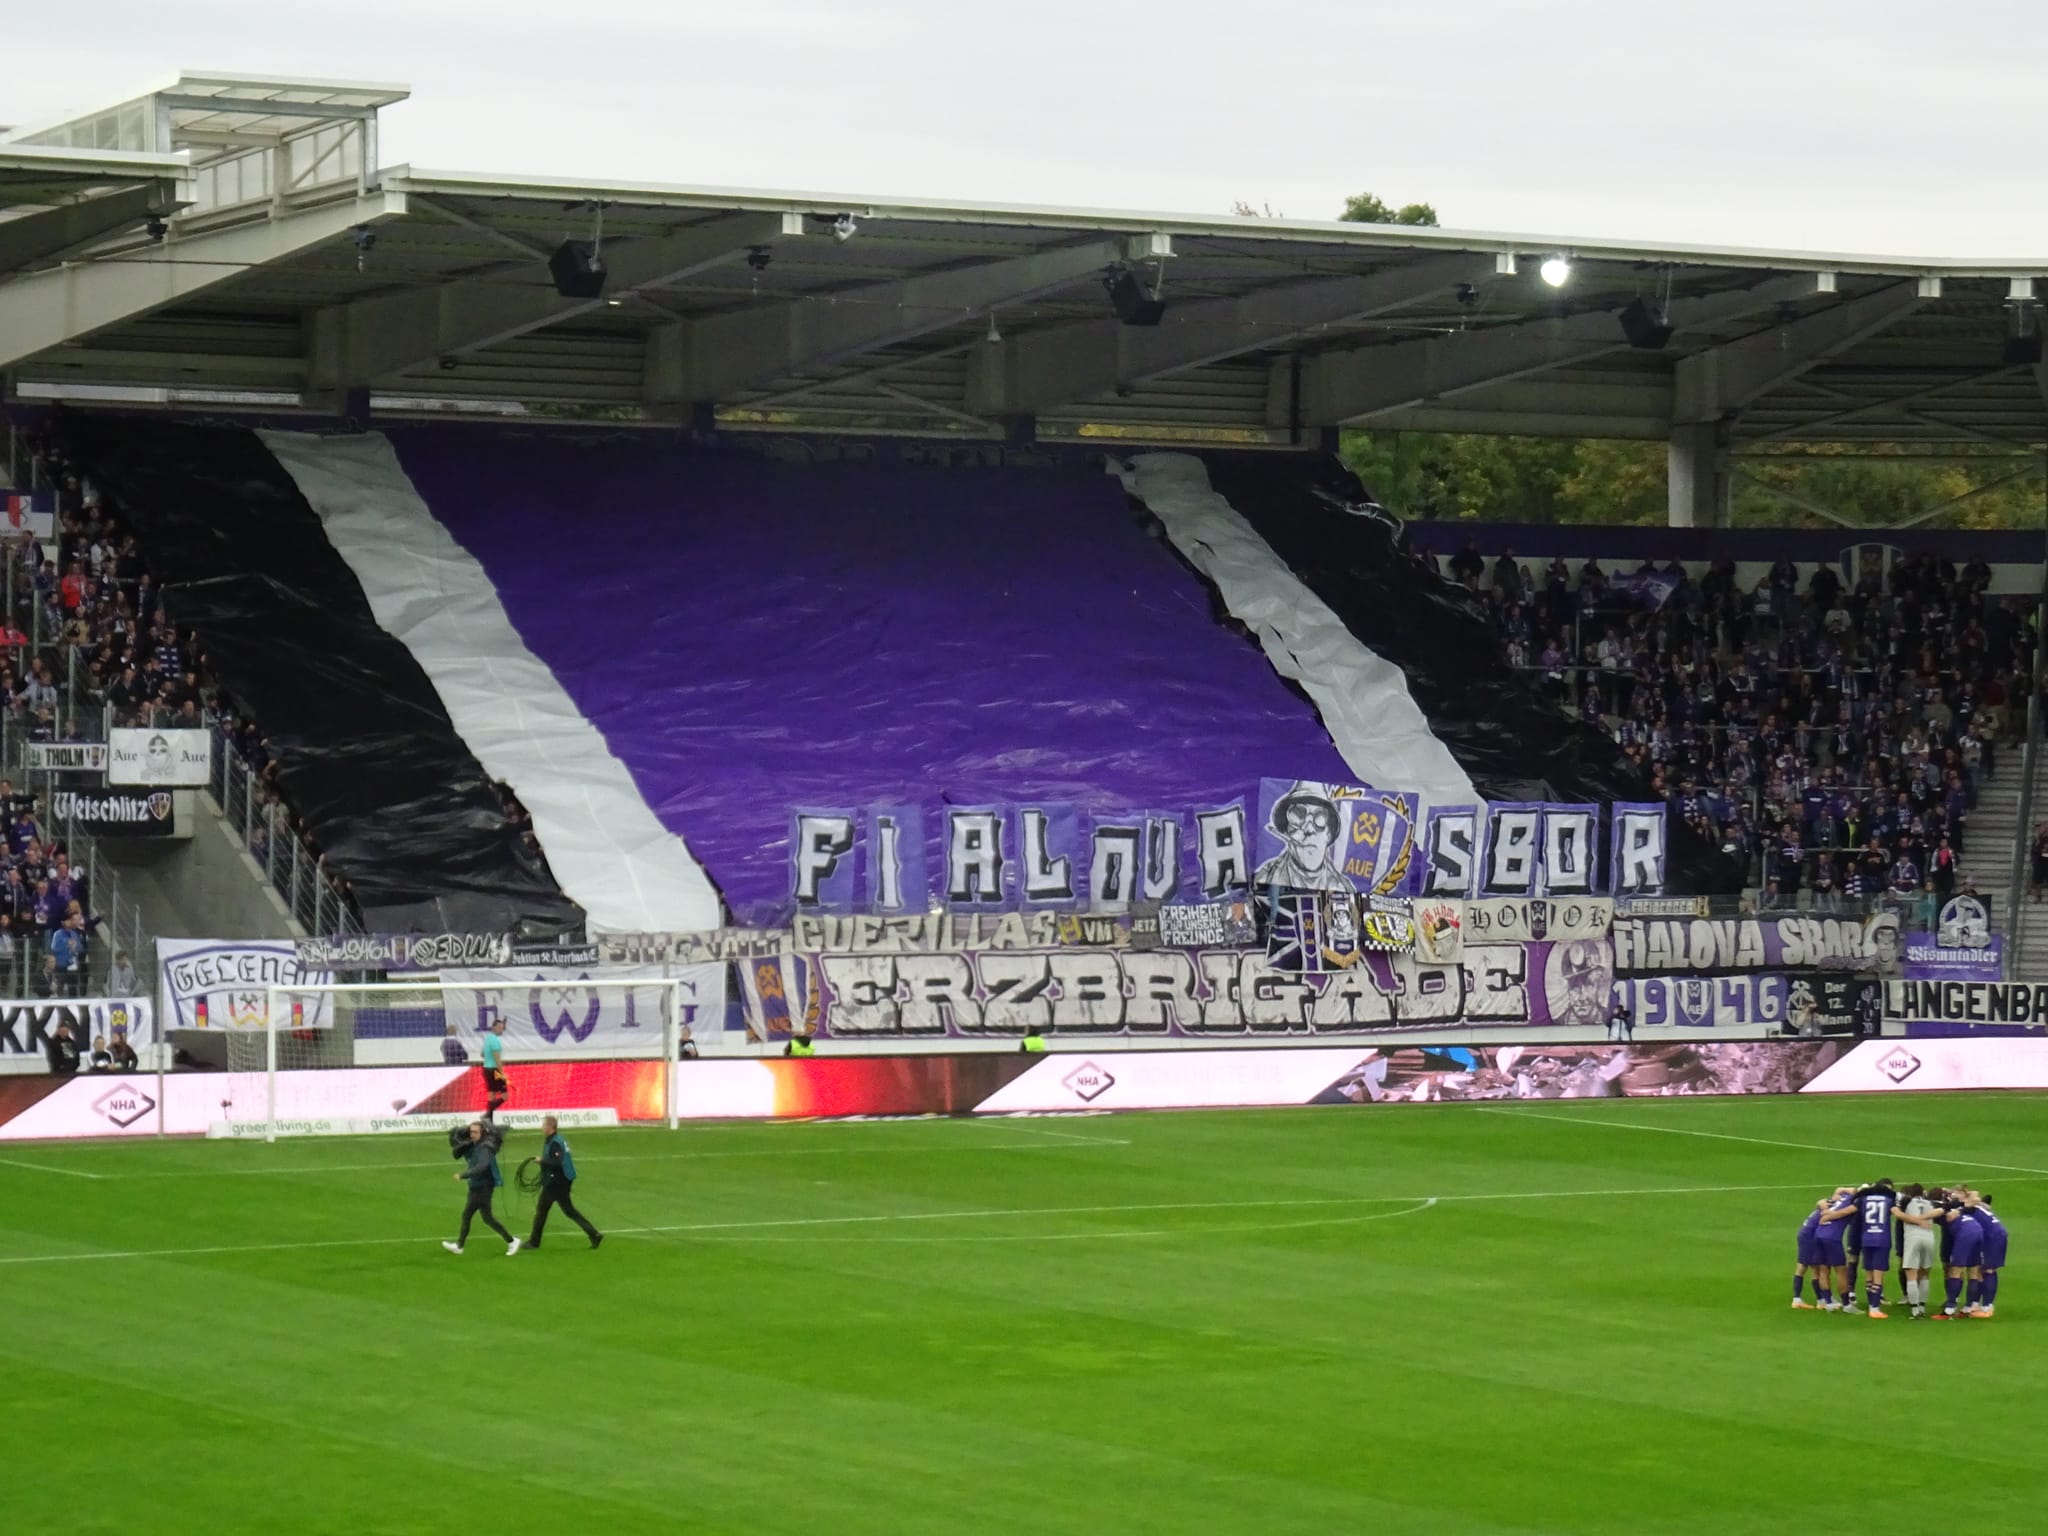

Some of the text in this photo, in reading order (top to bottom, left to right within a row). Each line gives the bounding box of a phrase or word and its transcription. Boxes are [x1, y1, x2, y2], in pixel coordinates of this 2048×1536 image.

[113, 749, 206, 763] Aue Aue
[54, 792, 149, 822] Weischlitz
[1426, 808, 1665, 898] SBOR
[1344, 858, 1374, 878] AUE
[793, 910, 1057, 951] GUERILLAS
[1163, 928, 1225, 946] FREUNDE
[817, 942, 1533, 1038] ERZBRIGADE
[1824, 982, 1847, 994] Der
[1827, 998, 1845, 1009] 12.
[1884, 981, 2048, 1023] LANGENBA
[1888, 1059, 1908, 1070] NHA
[1077, 1077, 1099, 1087] NHA
[109, 1100, 136, 1111] NHA
[1865, 1201, 1886, 1224] 21
